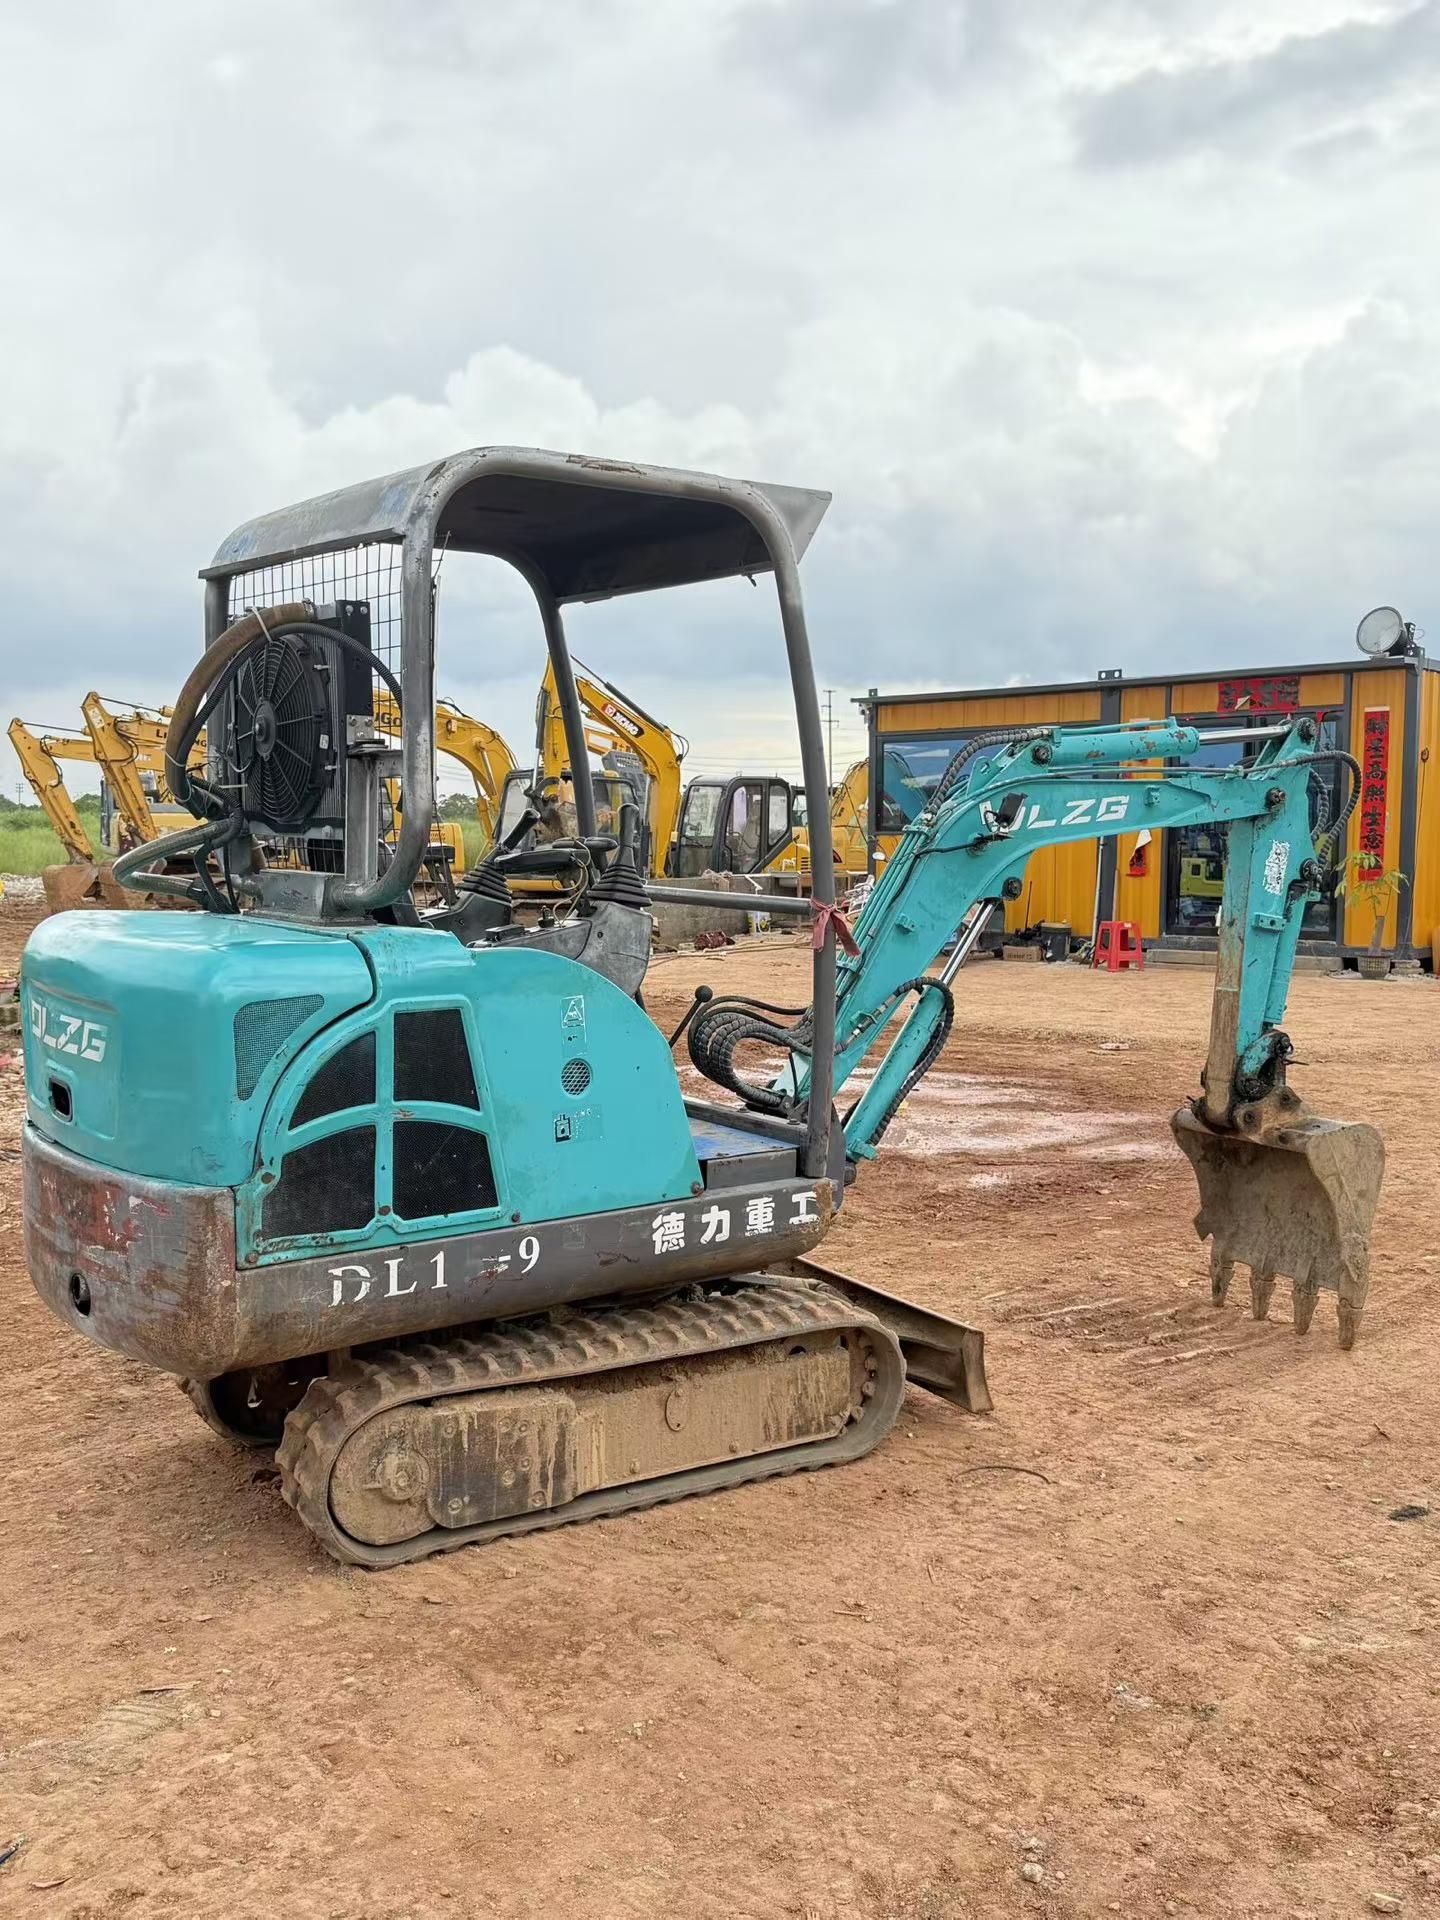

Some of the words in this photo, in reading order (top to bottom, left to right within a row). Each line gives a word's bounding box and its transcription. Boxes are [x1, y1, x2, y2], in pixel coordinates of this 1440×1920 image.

[31, 999, 107, 1063] DLZG
[652, 1191, 820, 1255] 德力重工
